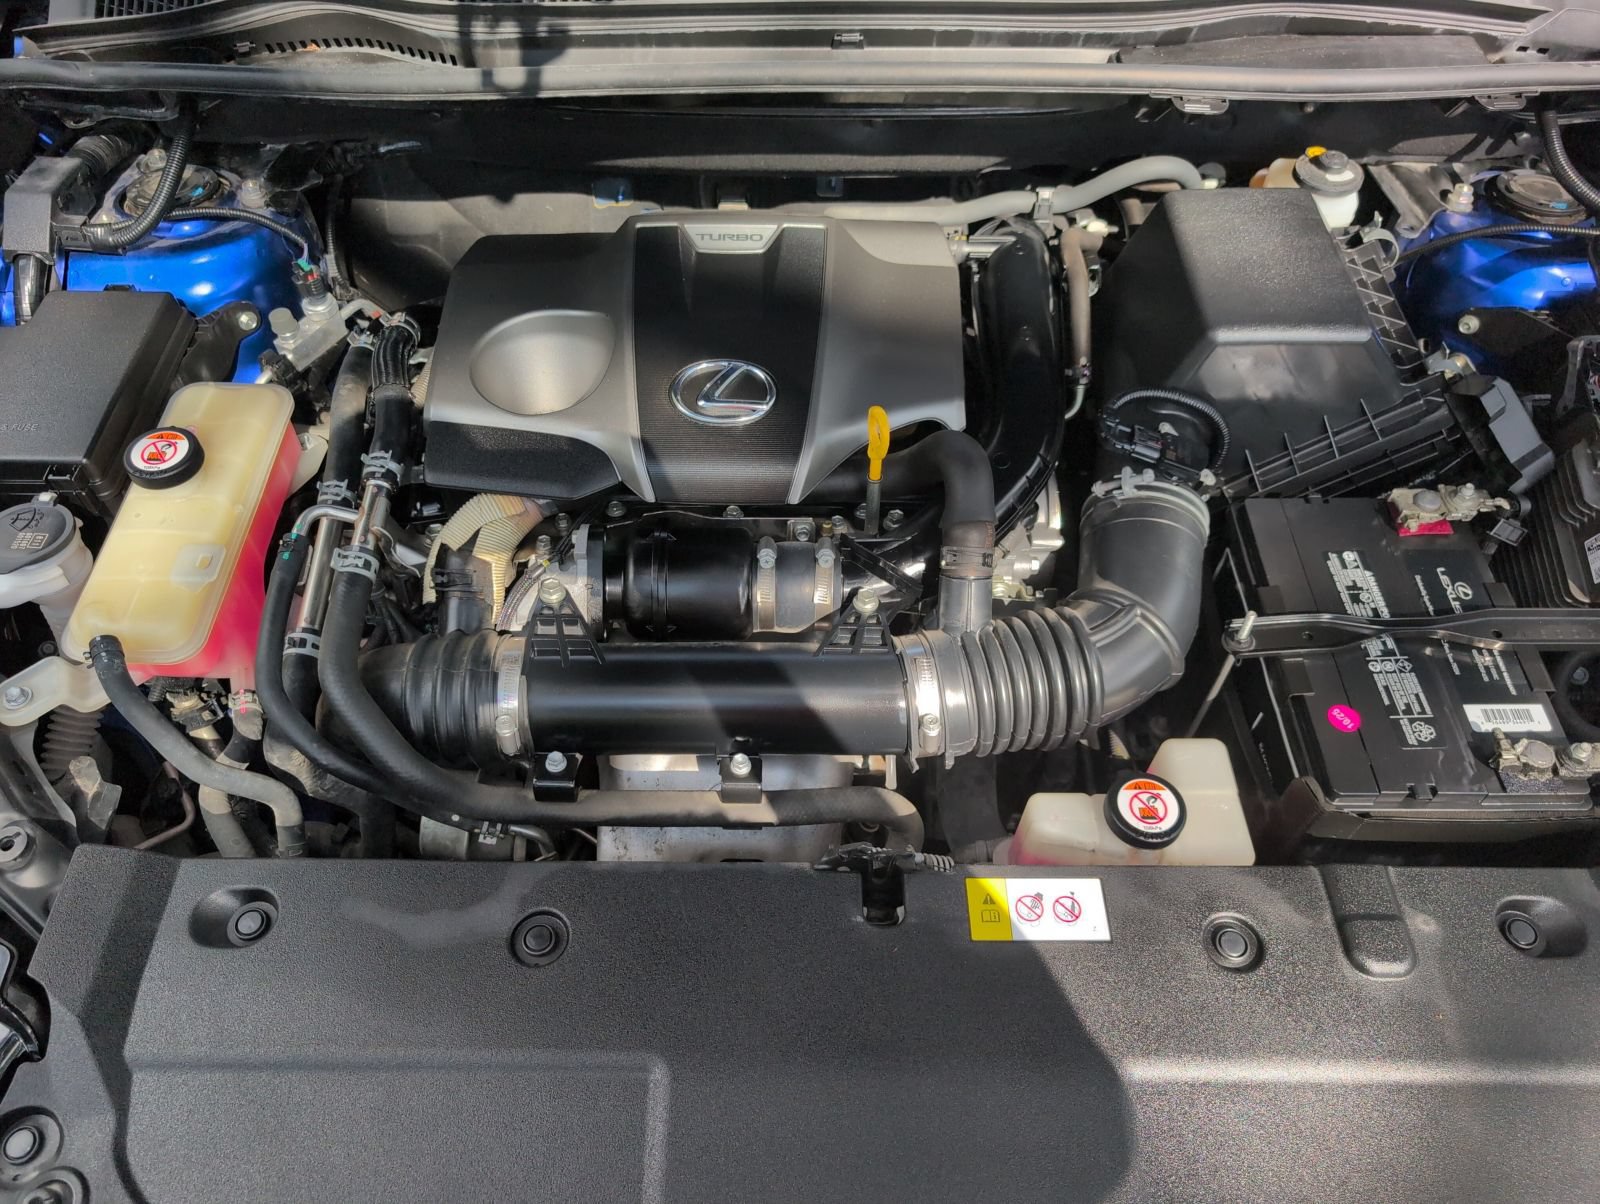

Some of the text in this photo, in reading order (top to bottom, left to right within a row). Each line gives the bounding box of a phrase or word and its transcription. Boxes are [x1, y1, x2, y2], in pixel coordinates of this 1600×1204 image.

[695, 233, 764, 241] TURBO
[11, 423, 39, 432] FUSE
[1436, 567, 1463, 613] LEXUS
